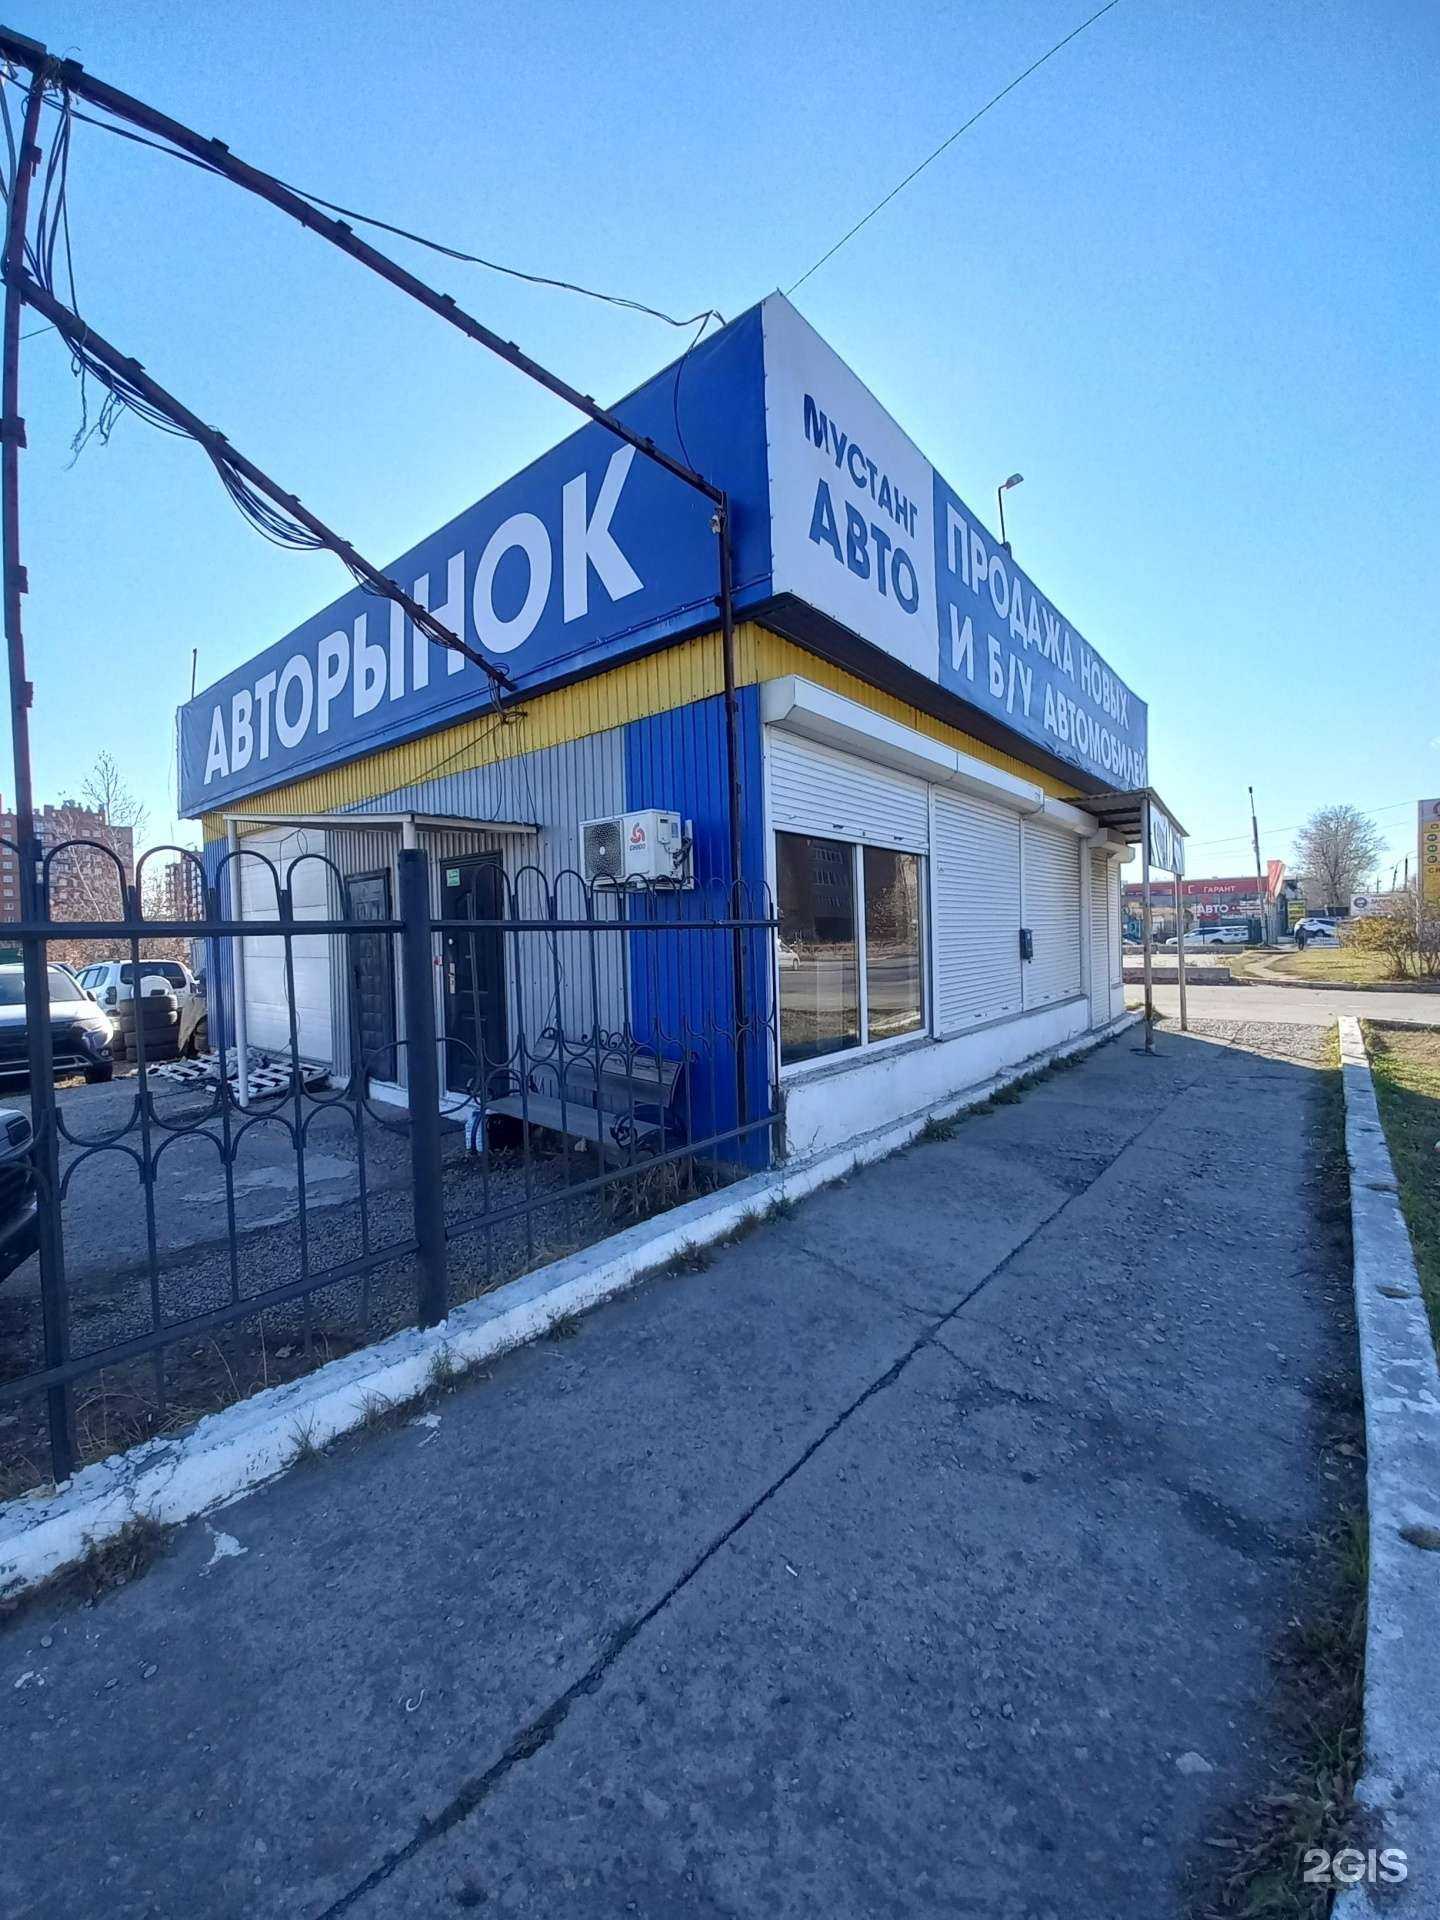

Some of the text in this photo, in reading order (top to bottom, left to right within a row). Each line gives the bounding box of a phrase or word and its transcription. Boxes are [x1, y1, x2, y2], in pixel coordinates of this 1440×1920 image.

[803, 394, 918, 539] МУСТАНГ
[809, 478, 919, 615] АВТО
[203, 442, 644, 785] АВТОРЫНОК
[947, 501, 1129, 730] ПРОДАЖА НОВЫХ
[950, 602, 975, 682] И
[1043, 683, 1146, 788] АВТОМОБИЛЕЙ
[1203, 885, 1236, 894] ГАРАНТ
